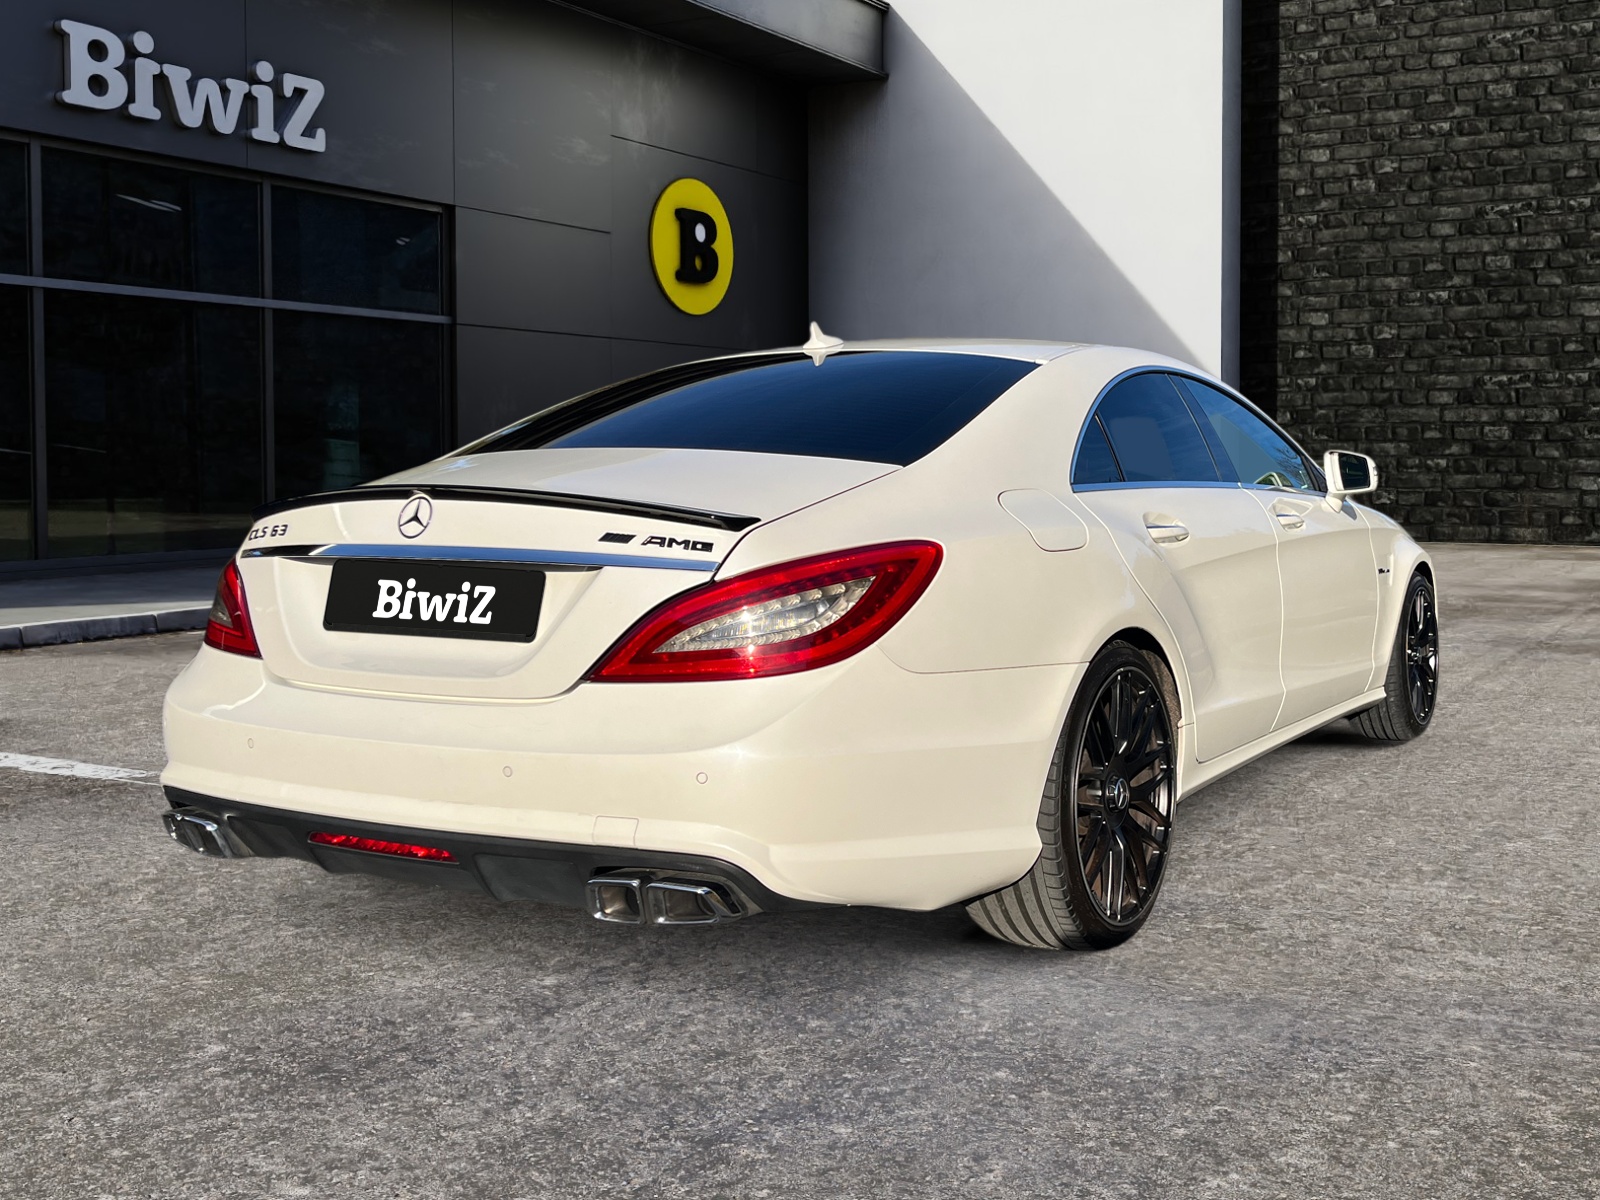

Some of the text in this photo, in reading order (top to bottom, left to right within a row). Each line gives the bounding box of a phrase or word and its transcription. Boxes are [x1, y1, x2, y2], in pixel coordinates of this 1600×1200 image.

[675, 208, 719, 284] B
[248, 524, 288, 541] CLS 63
[641, 536, 714, 552] AMG
